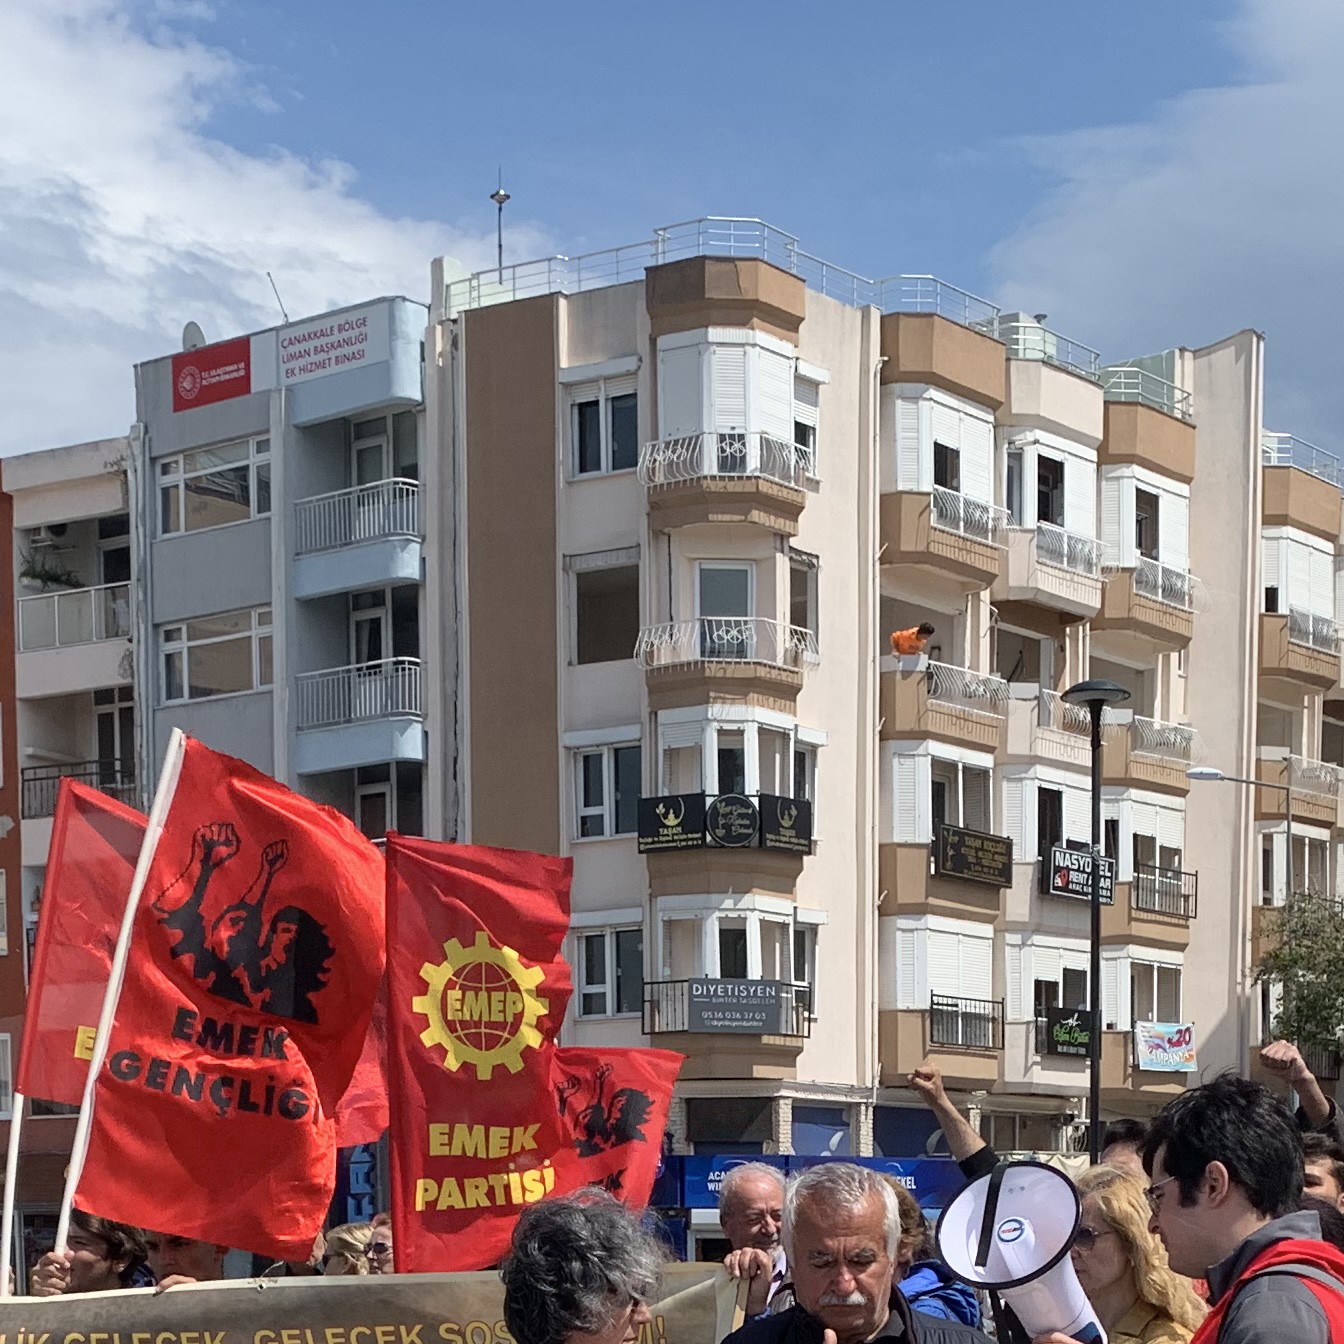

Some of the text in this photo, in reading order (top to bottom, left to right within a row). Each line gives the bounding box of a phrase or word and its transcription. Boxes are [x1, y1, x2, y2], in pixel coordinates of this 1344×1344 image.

[280, 316, 368, 349] ÇANAKKALE BÖLGE
[313, 332, 368, 357] BAŞKANLIĞI
[285, 366, 297, 379] EK
[298, 358, 331, 376] HİZMET
[1055, 851, 1112, 876] NASYOEL
[447, 989, 524, 1023] EMEP
[172, 1006, 290, 1061] EMEK
[429, 1123, 542, 1159] EMEK
[415, 1159, 555, 1212] PARTİSİ
